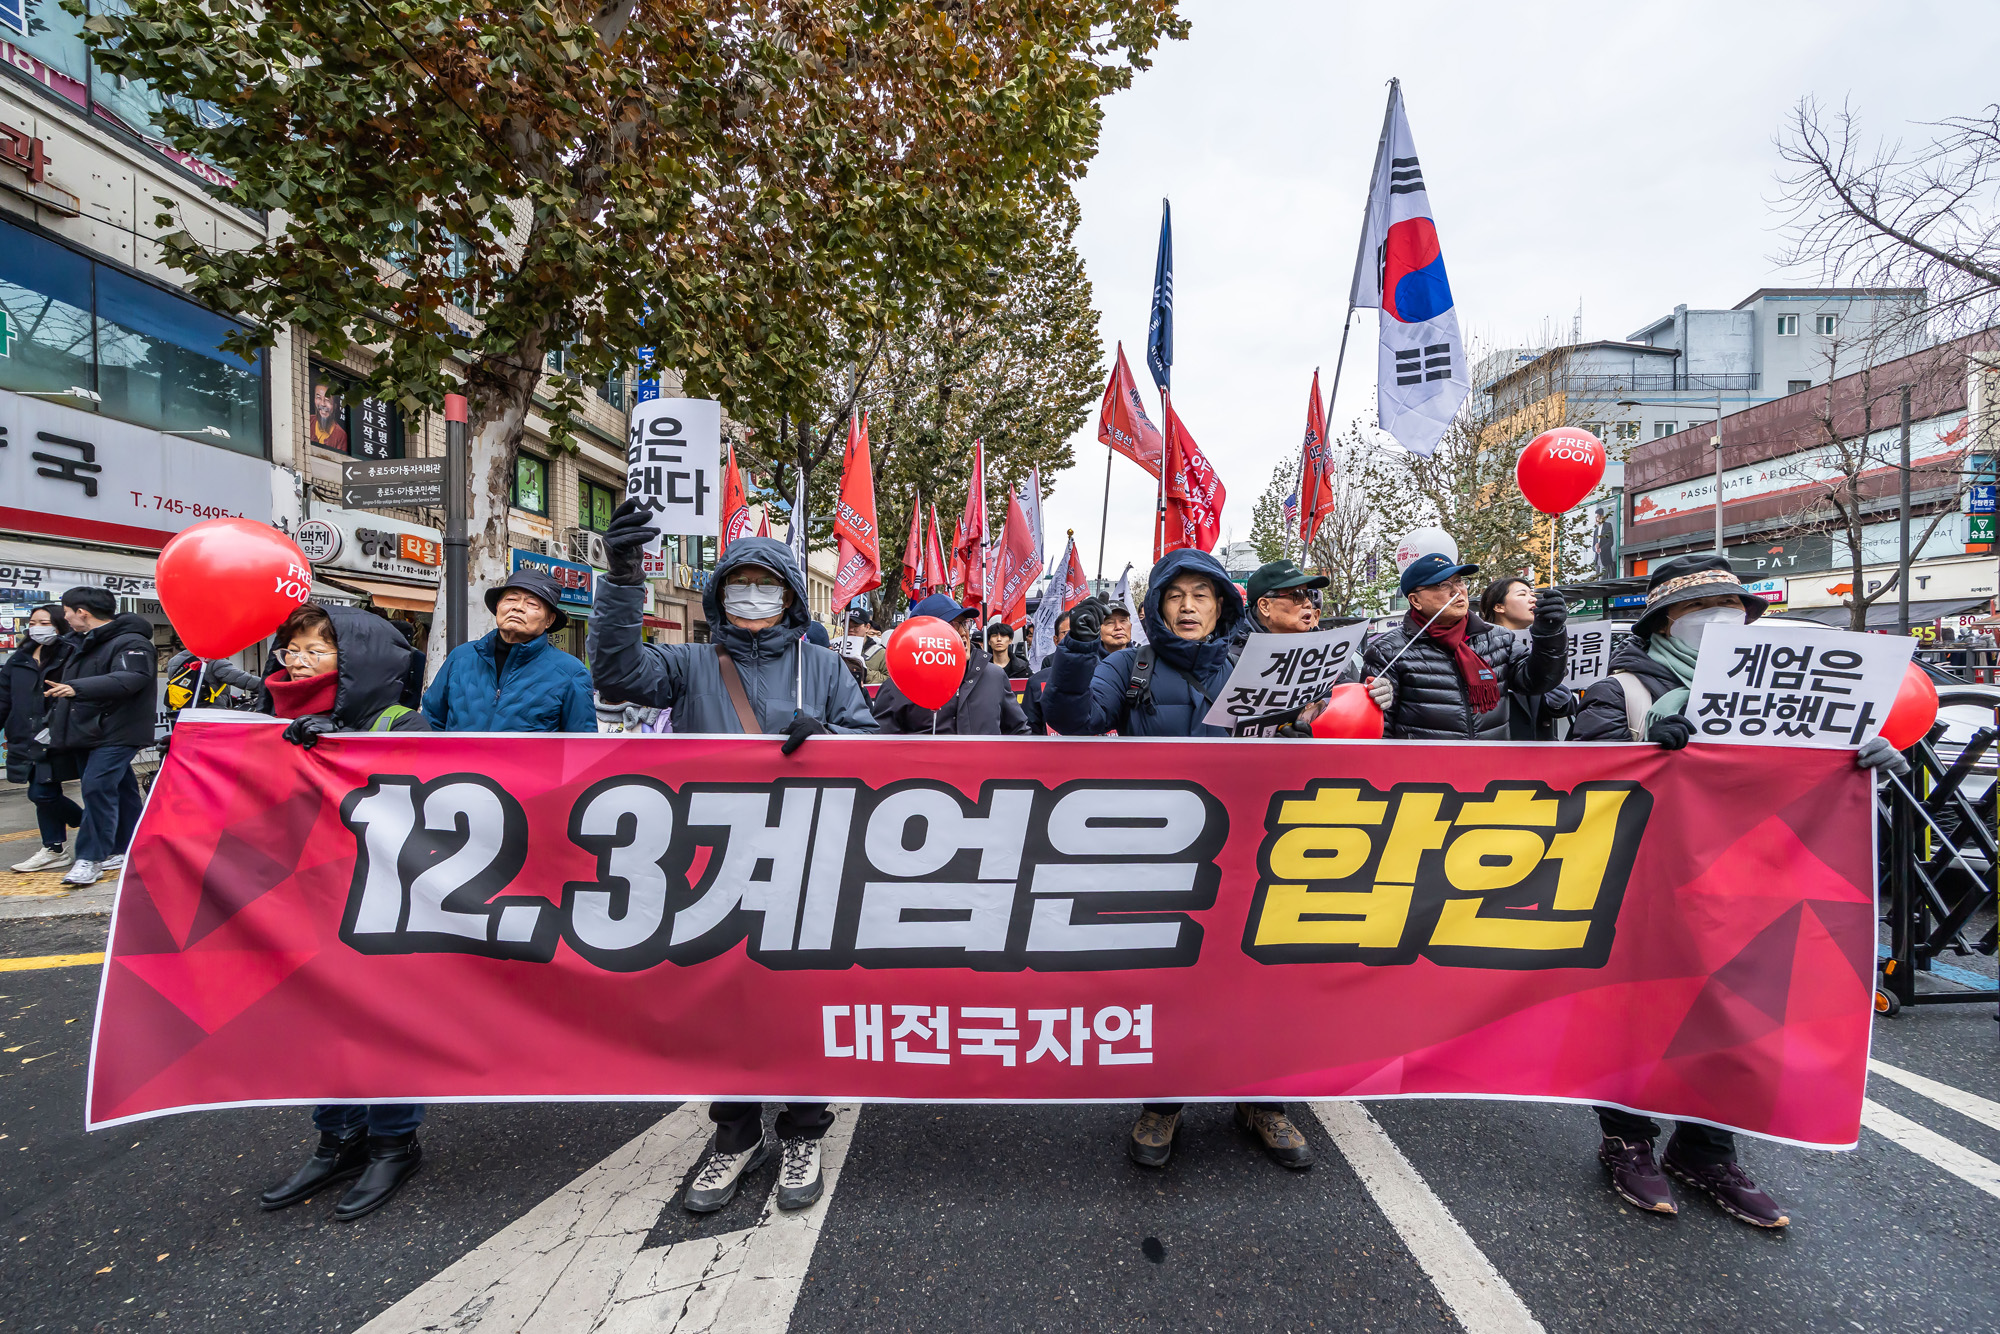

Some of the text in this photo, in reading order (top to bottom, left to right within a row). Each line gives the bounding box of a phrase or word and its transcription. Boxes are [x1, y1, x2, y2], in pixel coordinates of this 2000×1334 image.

[643, 390, 657, 399] 2F
[1557, 437, 1593, 452] FREE
[1549, 448, 1595, 466] YOON
[1760, 462, 1807, 482] ABOUT
[130, 491, 147, 509] T.
[300, 530, 330, 546] 백제
[1933, 529, 1954, 538] PAT
[1971, 530, 1995, 539] 슈올즈
[304, 545, 324, 556] 약국
[407, 538, 437, 565] 타올
[644, 561, 665, 572] 김밥
[0, 567, 43, 589] 약국
[103, 576, 142, 596] 원조
[553, 566, 592, 593] 의료기
[274, 576, 310, 604] YOO
[1959, 615, 1976, 626] 80
[1911, 625, 1937, 642] 85
[918, 636, 952, 651] FREE
[911, 650, 956, 667] YOON
[1260, 640, 1350, 686] 계엄은
[1727, 643, 1864, 695] 계엄은
[1697, 691, 1877, 745] 정당했다
[1253, 787, 1632, 951] 합헌
[822, 1003, 1153, 1067] 대전국자연
